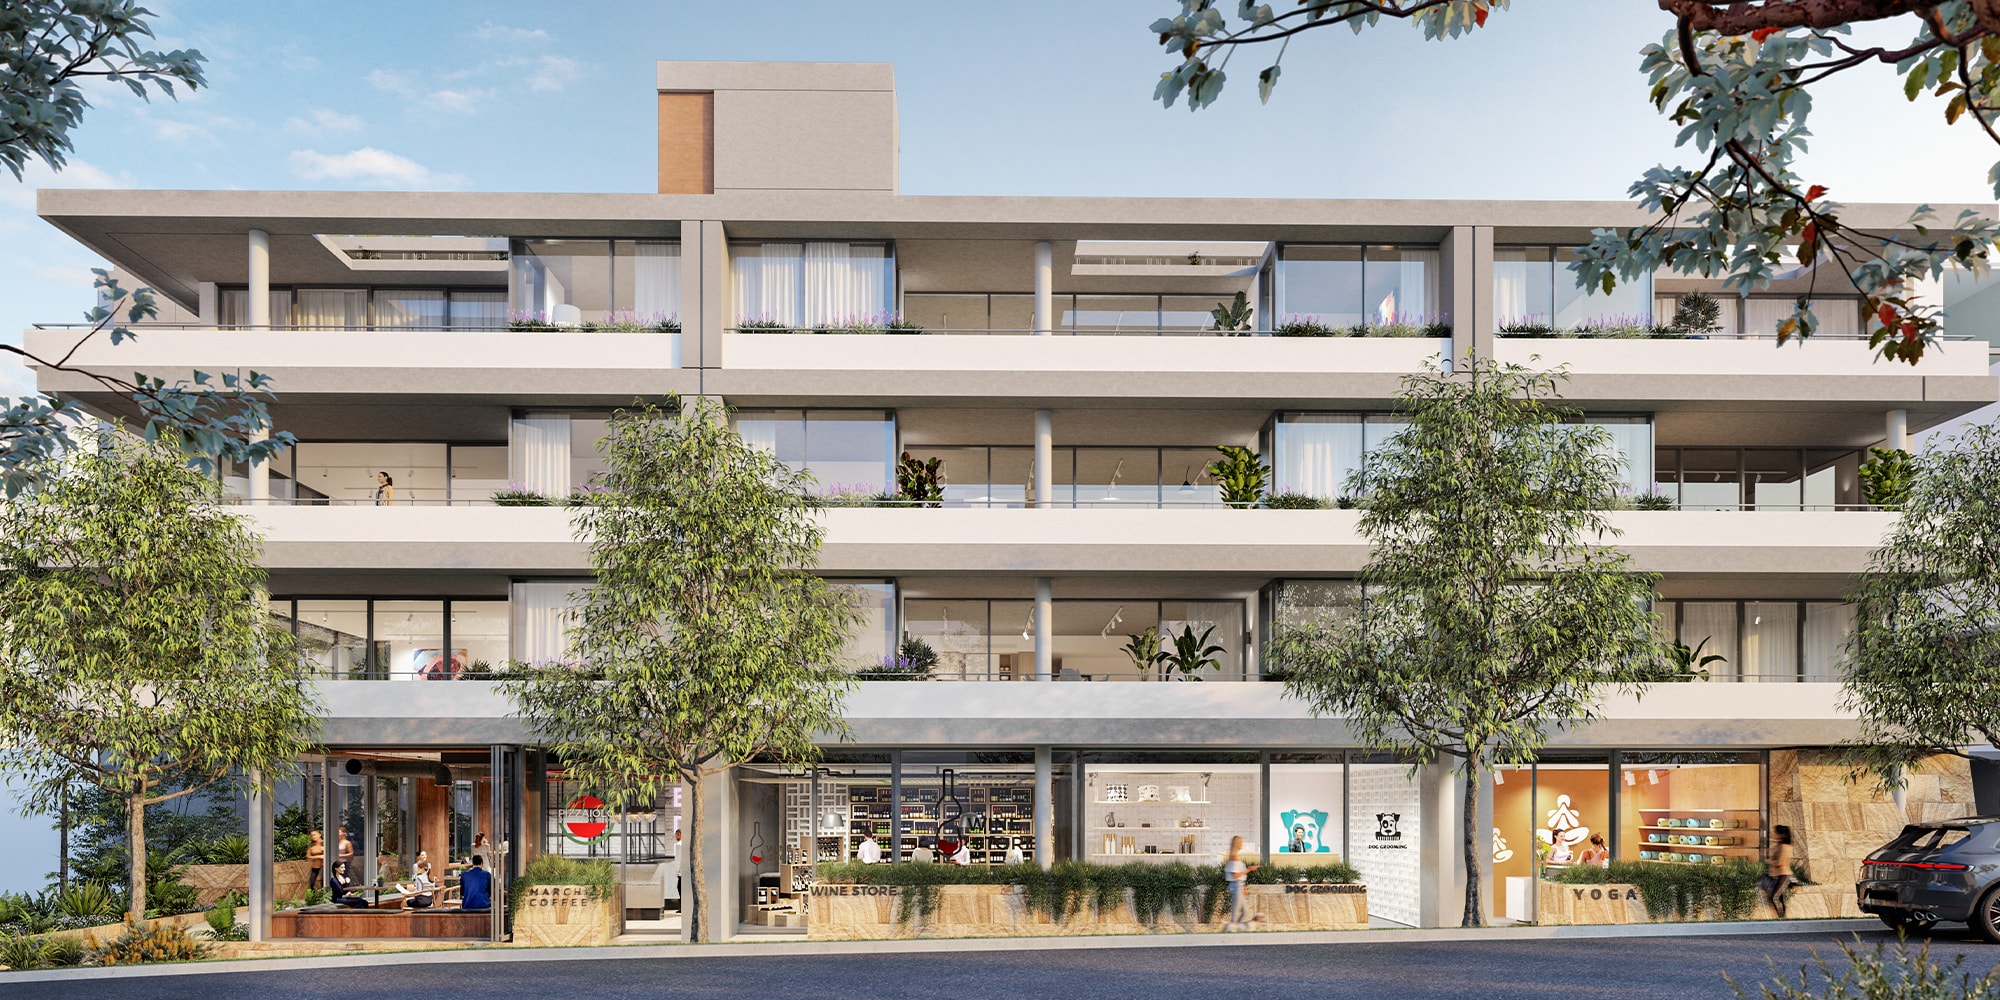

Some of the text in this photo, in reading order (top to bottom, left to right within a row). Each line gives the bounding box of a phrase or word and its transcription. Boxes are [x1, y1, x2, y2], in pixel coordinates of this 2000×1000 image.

[810, 886, 897, 896] WINE STORE
[1285, 885, 1367, 894] DOG GROOMING
[1573, 888, 1637, 900] YOGA
[529, 898, 588, 907] COFFEE
